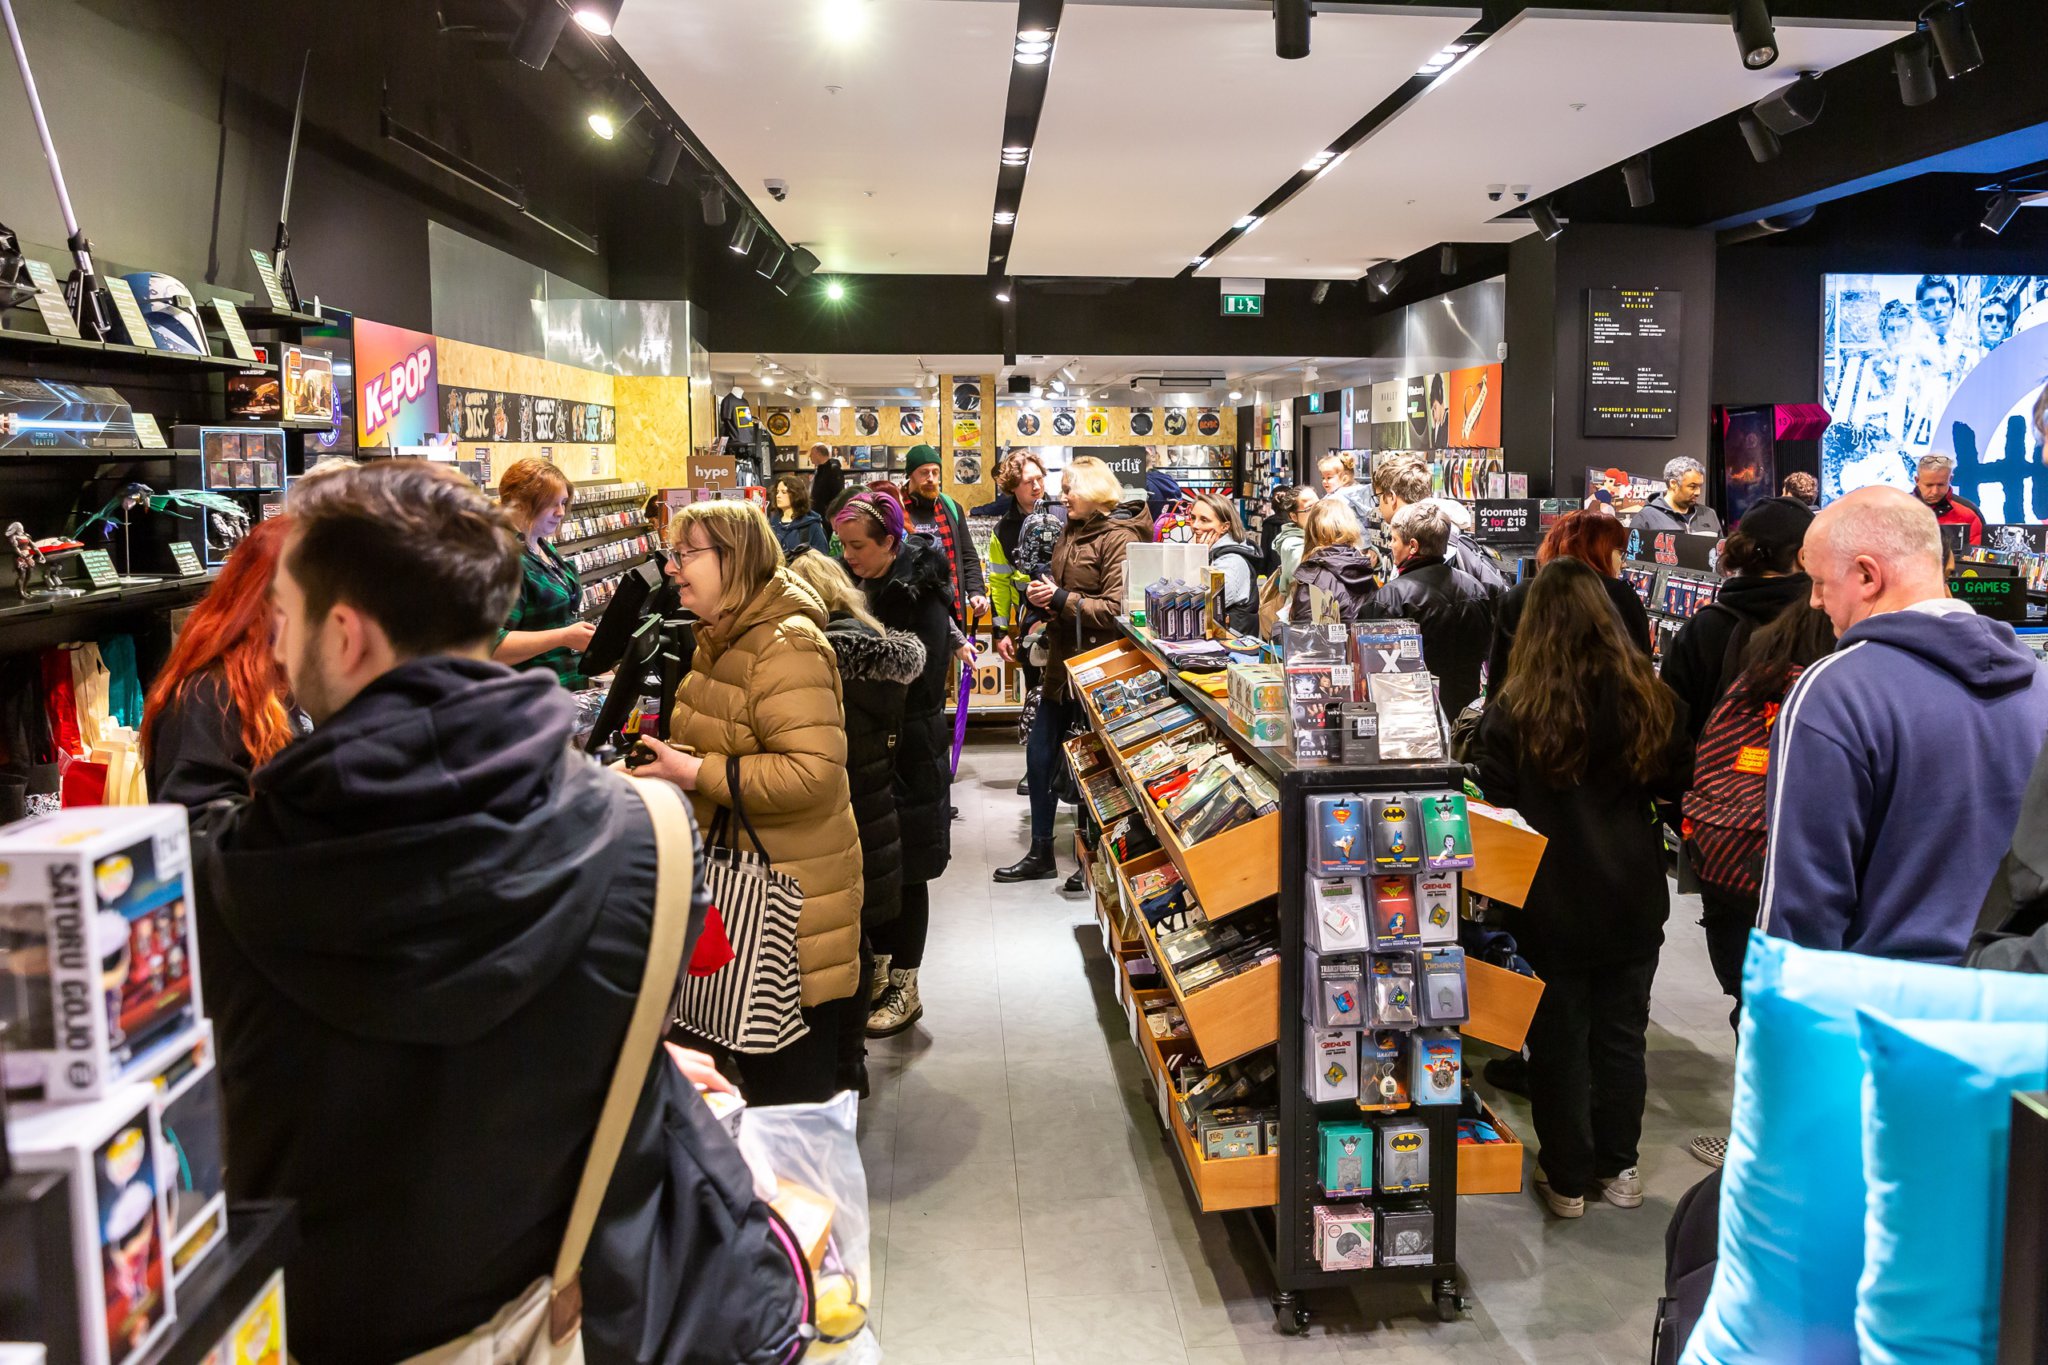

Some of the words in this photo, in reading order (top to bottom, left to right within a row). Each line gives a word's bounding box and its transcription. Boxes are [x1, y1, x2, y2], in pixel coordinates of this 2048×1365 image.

[364, 345, 432, 434] K-POP
[465, 407, 489, 438] DISC
[536, 413, 554, 440] DISC
[695, 465, 729, 480] hype
[1480, 507, 1528, 517] doormats
[1481, 518, 1488, 527] 2
[1490, 517, 1505, 527] for
[1507, 517, 1527, 527] £18
[1654, 532, 1676, 553] 4K
[1964, 581, 2011, 594] GAMES
[1378, 649, 1401, 672] X
[49, 862, 87, 970] SATORU
[1320, 964, 1360, 973] TRANSFORMERS
[61, 980, 94, 1051] GOJO
[1320, 1040, 1351, 1049] GREMLINS
